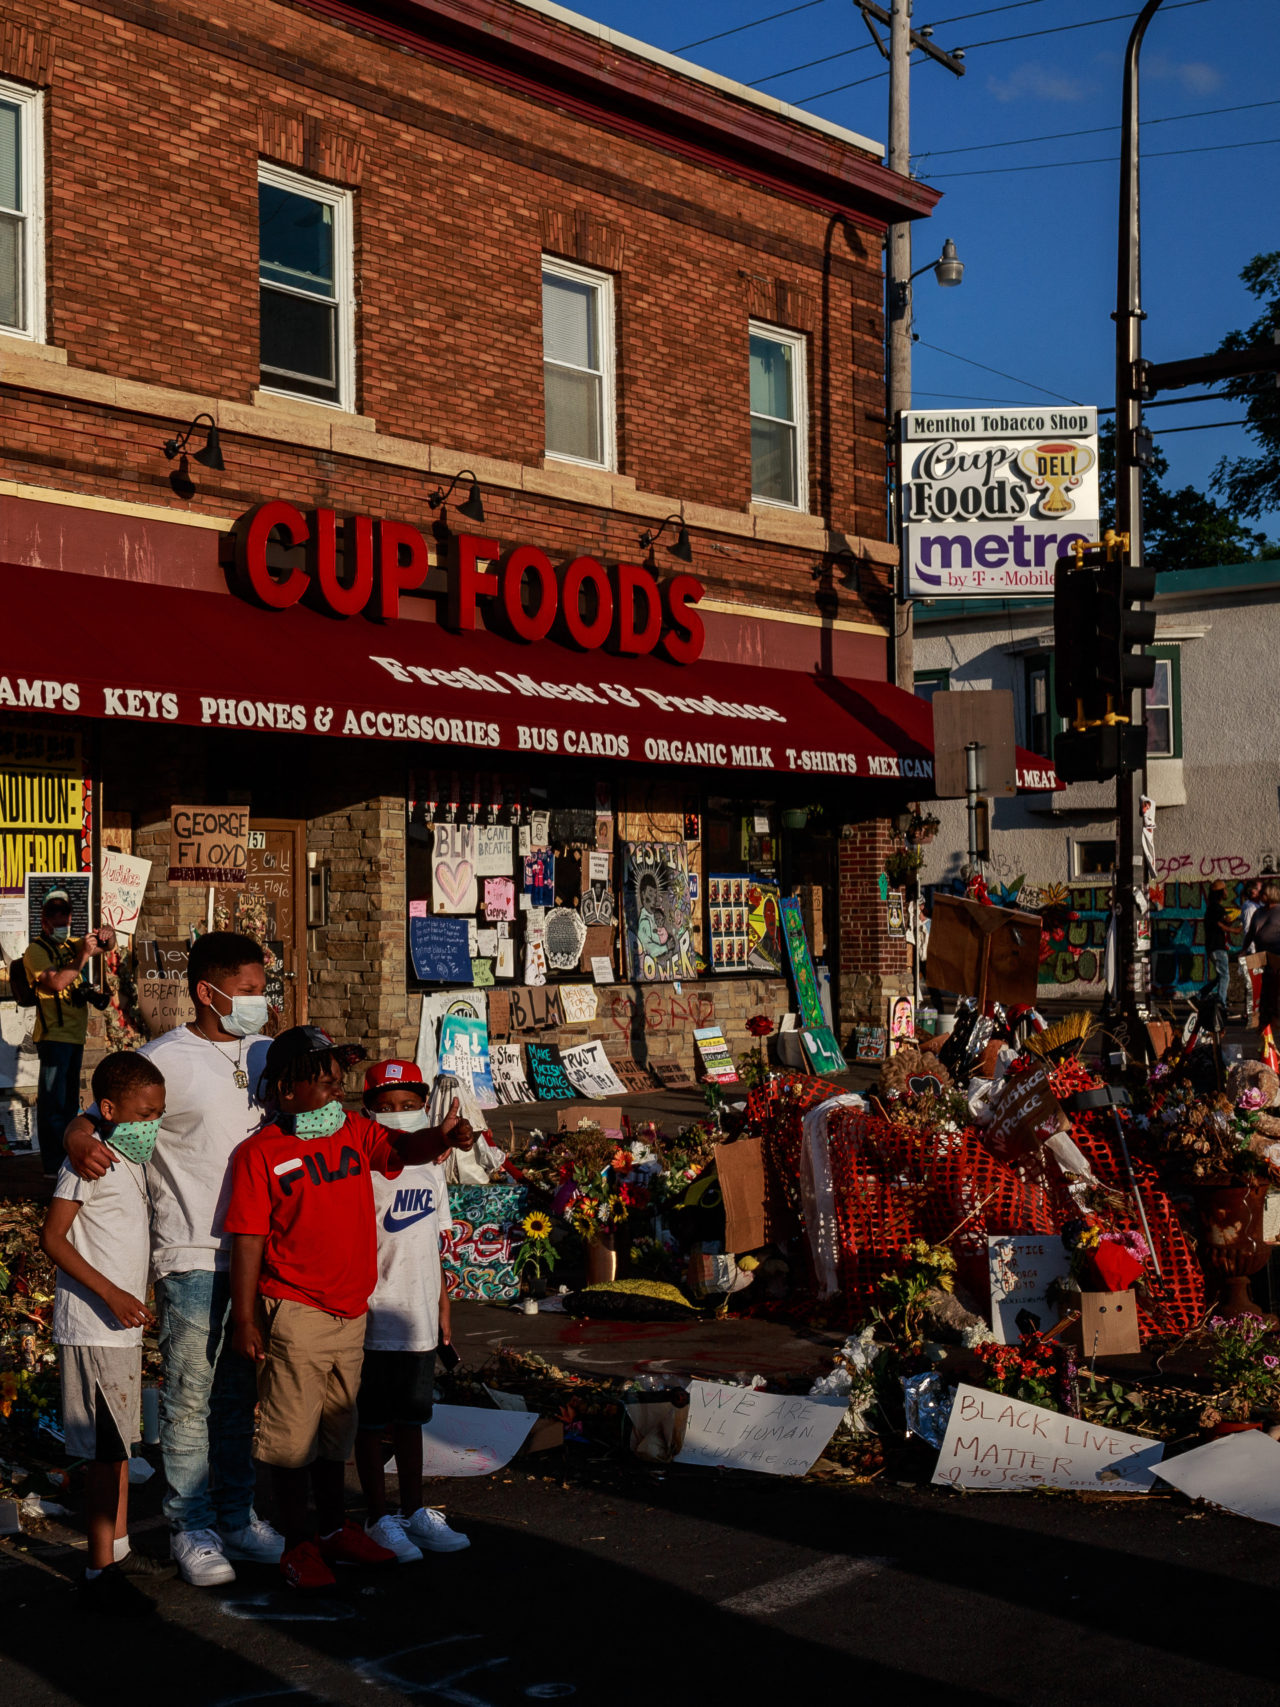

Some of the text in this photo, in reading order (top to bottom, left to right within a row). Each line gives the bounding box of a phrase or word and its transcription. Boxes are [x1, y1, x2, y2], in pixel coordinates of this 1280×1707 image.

[914, 414, 1088, 434] Menthol Tobacco Shop
[923, 441, 1016, 487] Cup
[1037, 456, 1076, 477] DELI
[913, 480, 1026, 516] Foods
[246, 499, 706, 665] CUP FOODS
[948, 572, 968, 591] by
[369, 655, 787, 724] Fresh Meat & Produce
[102, 687, 179, 721] KEYS
[200, 697, 307, 732] PHONES
[313, 707, 334, 732] &
[342, 709, 500, 748] ACCESSORIES
[517, 726, 558, 752] BUS
[564, 729, 629, 758] CARDS
[644, 738, 727, 766] ORGANIC
[731, 745, 775, 769] MILK
[786, 749, 857, 774] T-SHIRTS
[867, 755, 933, 779] MEXICAN
[1023, 770, 1056, 788] MEAT
[173, 812, 248, 839] GEORGE
[435, 825, 475, 859] BLM
[478, 842, 512, 856] BREATHE
[628, 842, 689, 876] REST IN
[486, 902, 508, 919] George
[143, 983, 190, 1000] BREATHI
[512, 989, 564, 1027] BLM
[497, 1046, 519, 1067] Story
[528, 1044, 552, 1061] MAKE
[561, 1046, 597, 1069] TRUST
[803, 1031, 847, 1070] BLM
[531, 1058, 566, 1077] RACISM
[534, 1073, 568, 1088] WRONG
[538, 1086, 576, 1100] AGAIN
[997, 1070, 1045, 1121] Justice
[273, 1146, 361, 1196] FILA
[392, 1189, 433, 1213] NIKE
[994, 1243, 1044, 1256] JUSTICE
[998, 1258, 1019, 1272] FOR
[701, 1387, 817, 1420] WE ARE
[960, 1395, 1143, 1458] BLACK LIVES
[741, 1449, 778, 1463] THE
[953, 1437, 1073, 1476] MATTER
[969, 1465, 992, 1478] to
[989, 1467, 1059, 1485] Jesus
